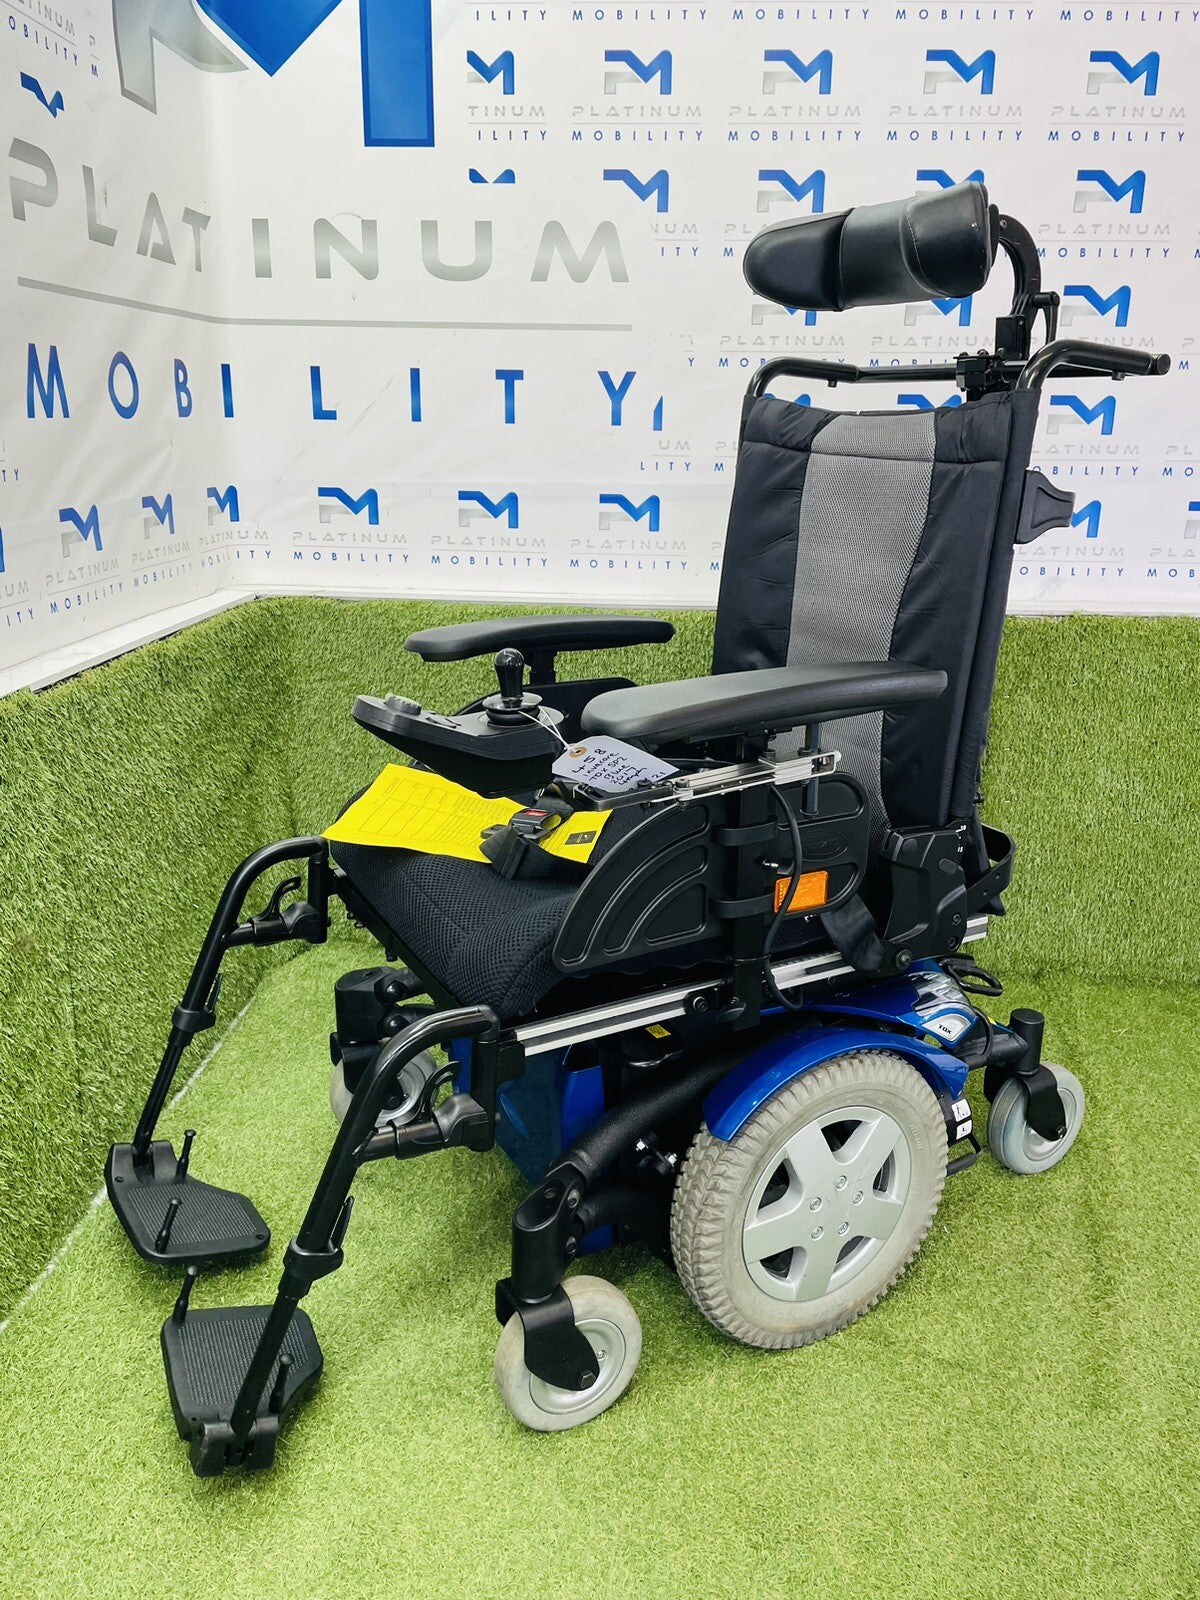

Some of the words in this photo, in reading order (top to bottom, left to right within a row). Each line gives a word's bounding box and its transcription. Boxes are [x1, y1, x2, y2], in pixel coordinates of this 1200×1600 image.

[476, 10, 547, 22] ILITY
[572, 10, 707, 22] MOBILITY
[732, 9, 869, 21] MOBILITY
[895, 9, 1034, 22] MOBILITY
[1059, 10, 1200, 23] MOBILITY
[9, 15, 78, 66] OBILITY
[572, 106, 702, 119] PLATINUM
[729, 106, 861, 118] PLATINUM
[888, 106, 1023, 118] PLATINUM
[1050, 106, 1186, 120] PLATINUM
[478, 131, 547, 142] ILITY
[571, 131, 703, 143] MOBILITY
[727, 131, 861, 143] MOBILITY
[886, 131, 1022, 143] MOBILITY
[1047, 131, 1185, 143] MOBILITY
[8, 138, 630, 283] PLATINUM
[1038, 224, 1170, 236] PLATINUM
[719, 336, 845, 348] PLATINUM
[26, 342, 638, 428] MOBILITY
[1032, 465, 1139, 477] OBILITY
[292, 532, 408, 545] PLATINUM
[430, 536, 546, 549] PLATINUM
[570, 539, 687, 551] PLATINUM
[1016, 545, 1125, 558] LATINUM
[293, 552, 409, 564] MOBILITY
[431, 556, 547, 568] MOBILITY
[569, 559, 687, 571] MOBILITY
[46, 558, 120, 587] PLATINUM
[1019, 566, 1124, 577] OBILITY
[50, 581, 125, 614] MOBILITY
